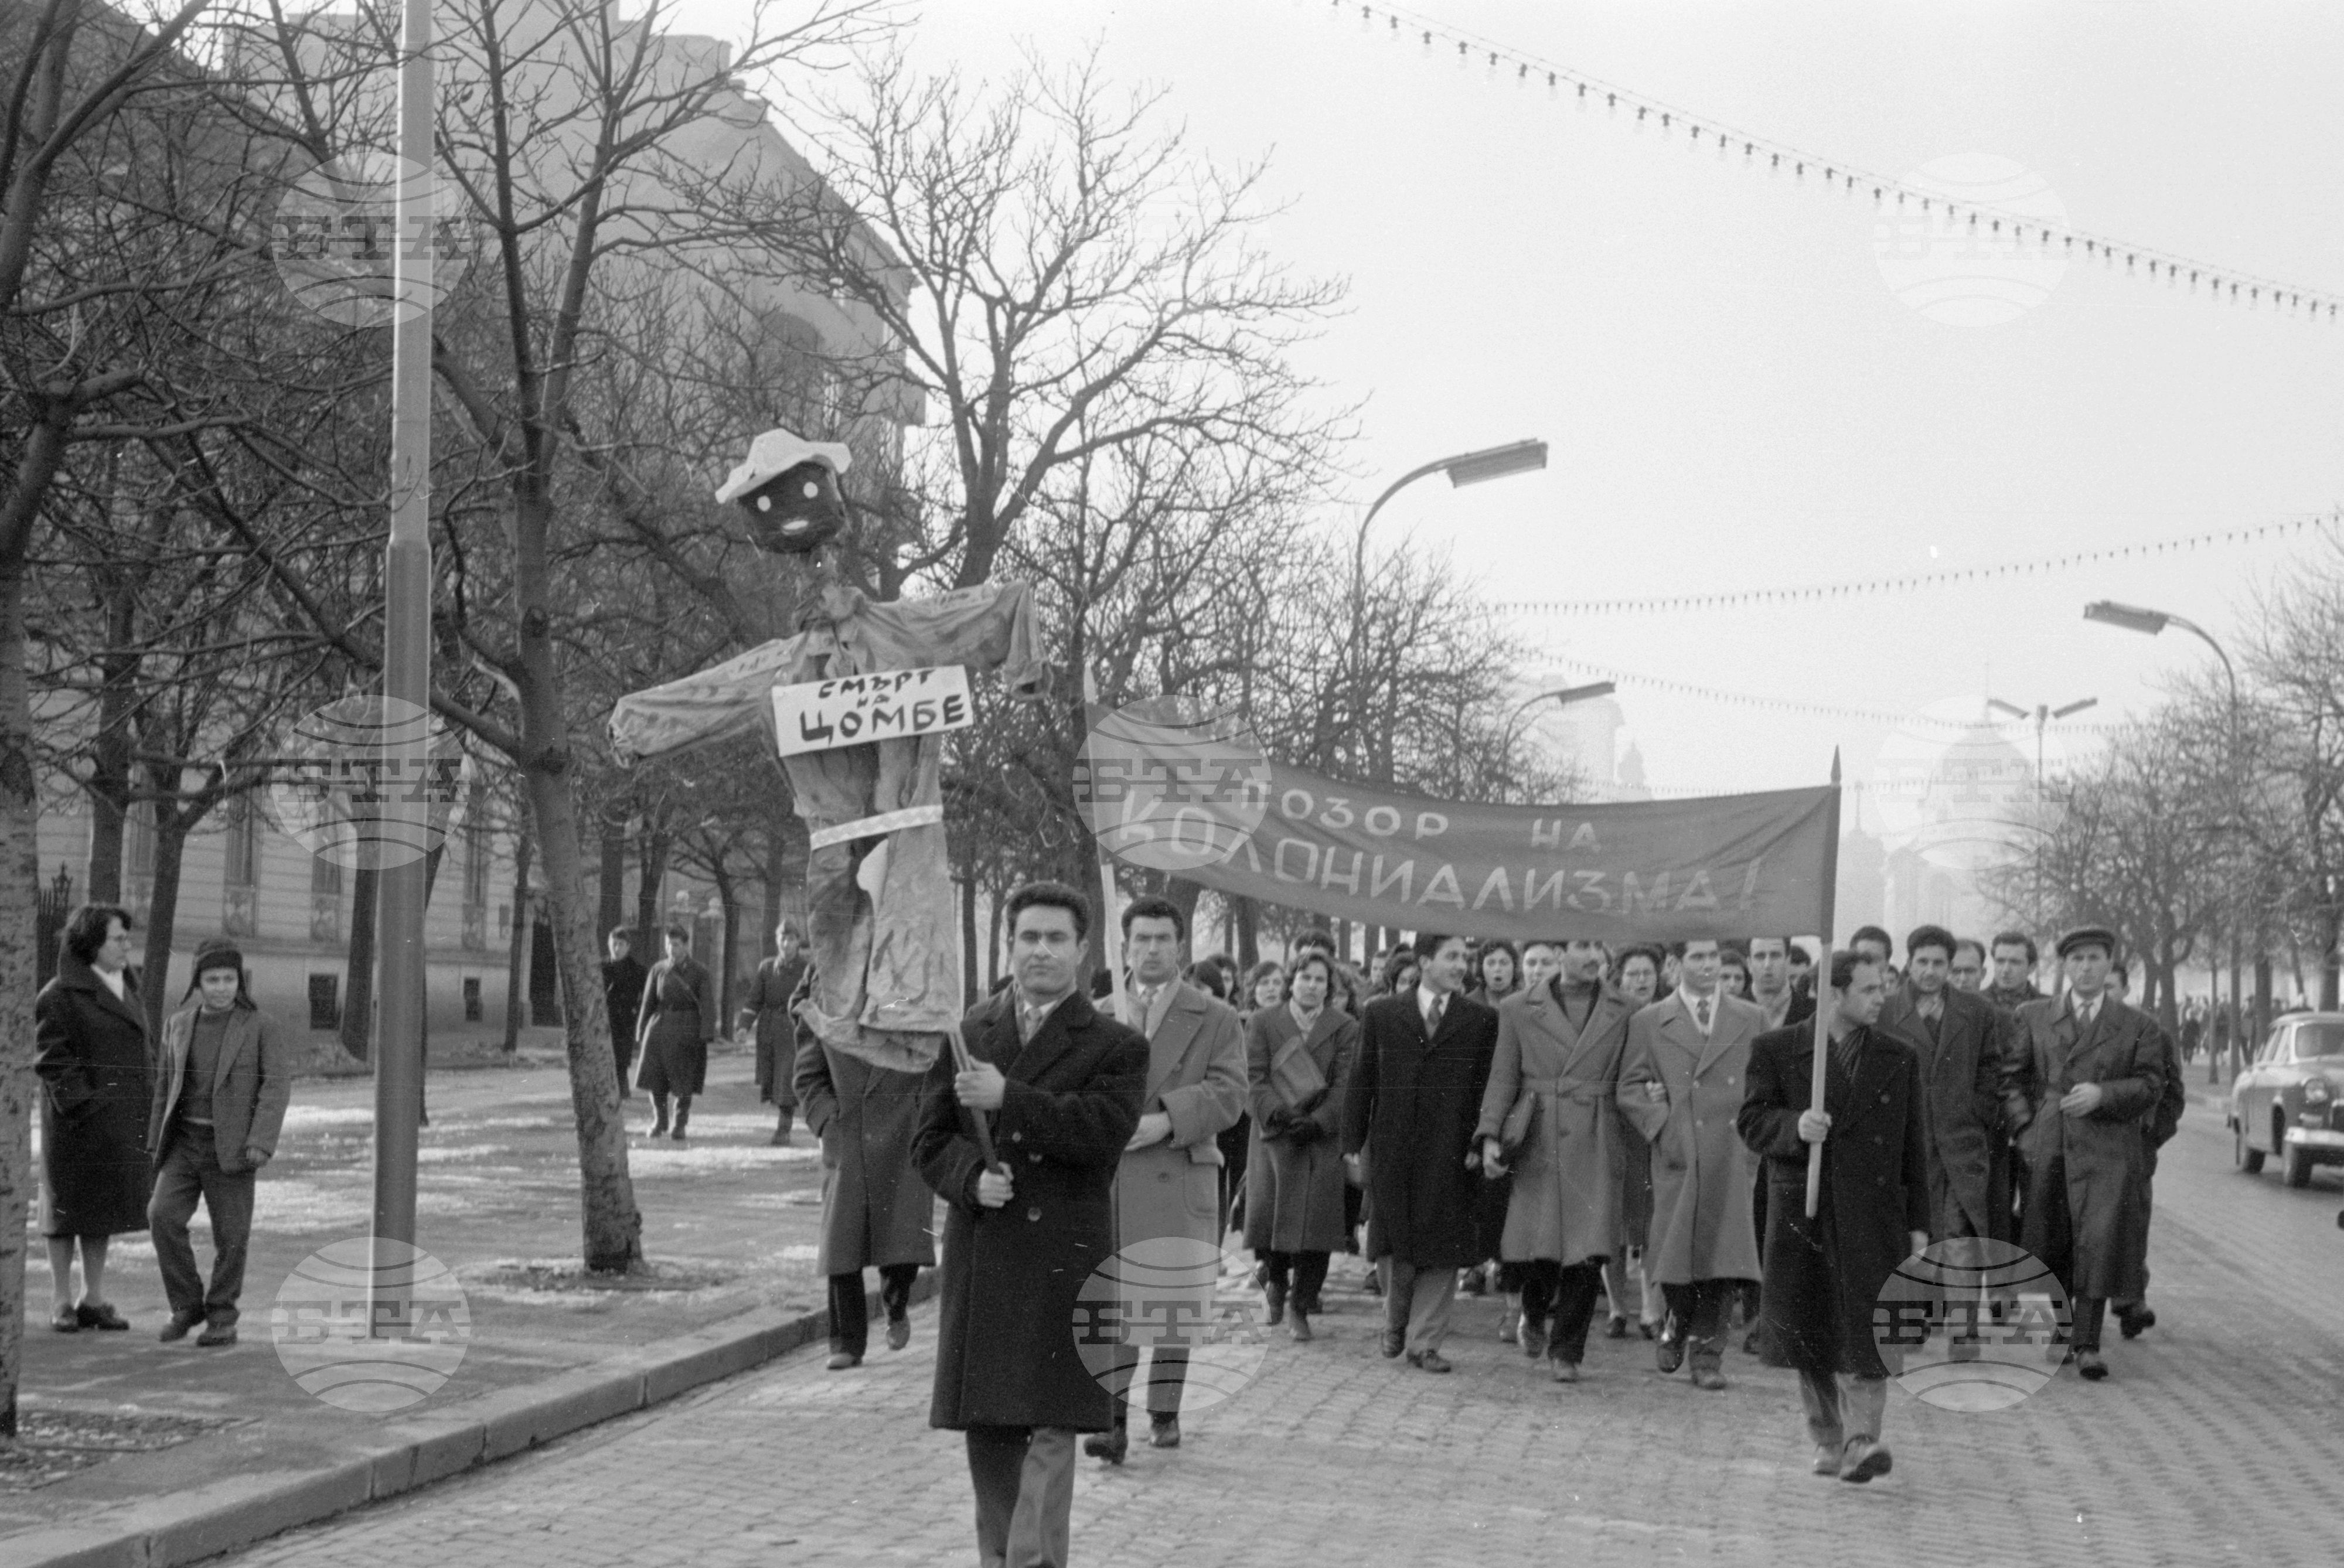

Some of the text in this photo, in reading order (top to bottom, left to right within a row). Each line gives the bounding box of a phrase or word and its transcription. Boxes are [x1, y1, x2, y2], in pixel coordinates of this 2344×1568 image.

[818, 669, 936, 698] СМЪРТ
[799, 694, 965, 746] ЦОМБЕ
[1241, 776, 1602, 853] ПОЗОР НА
